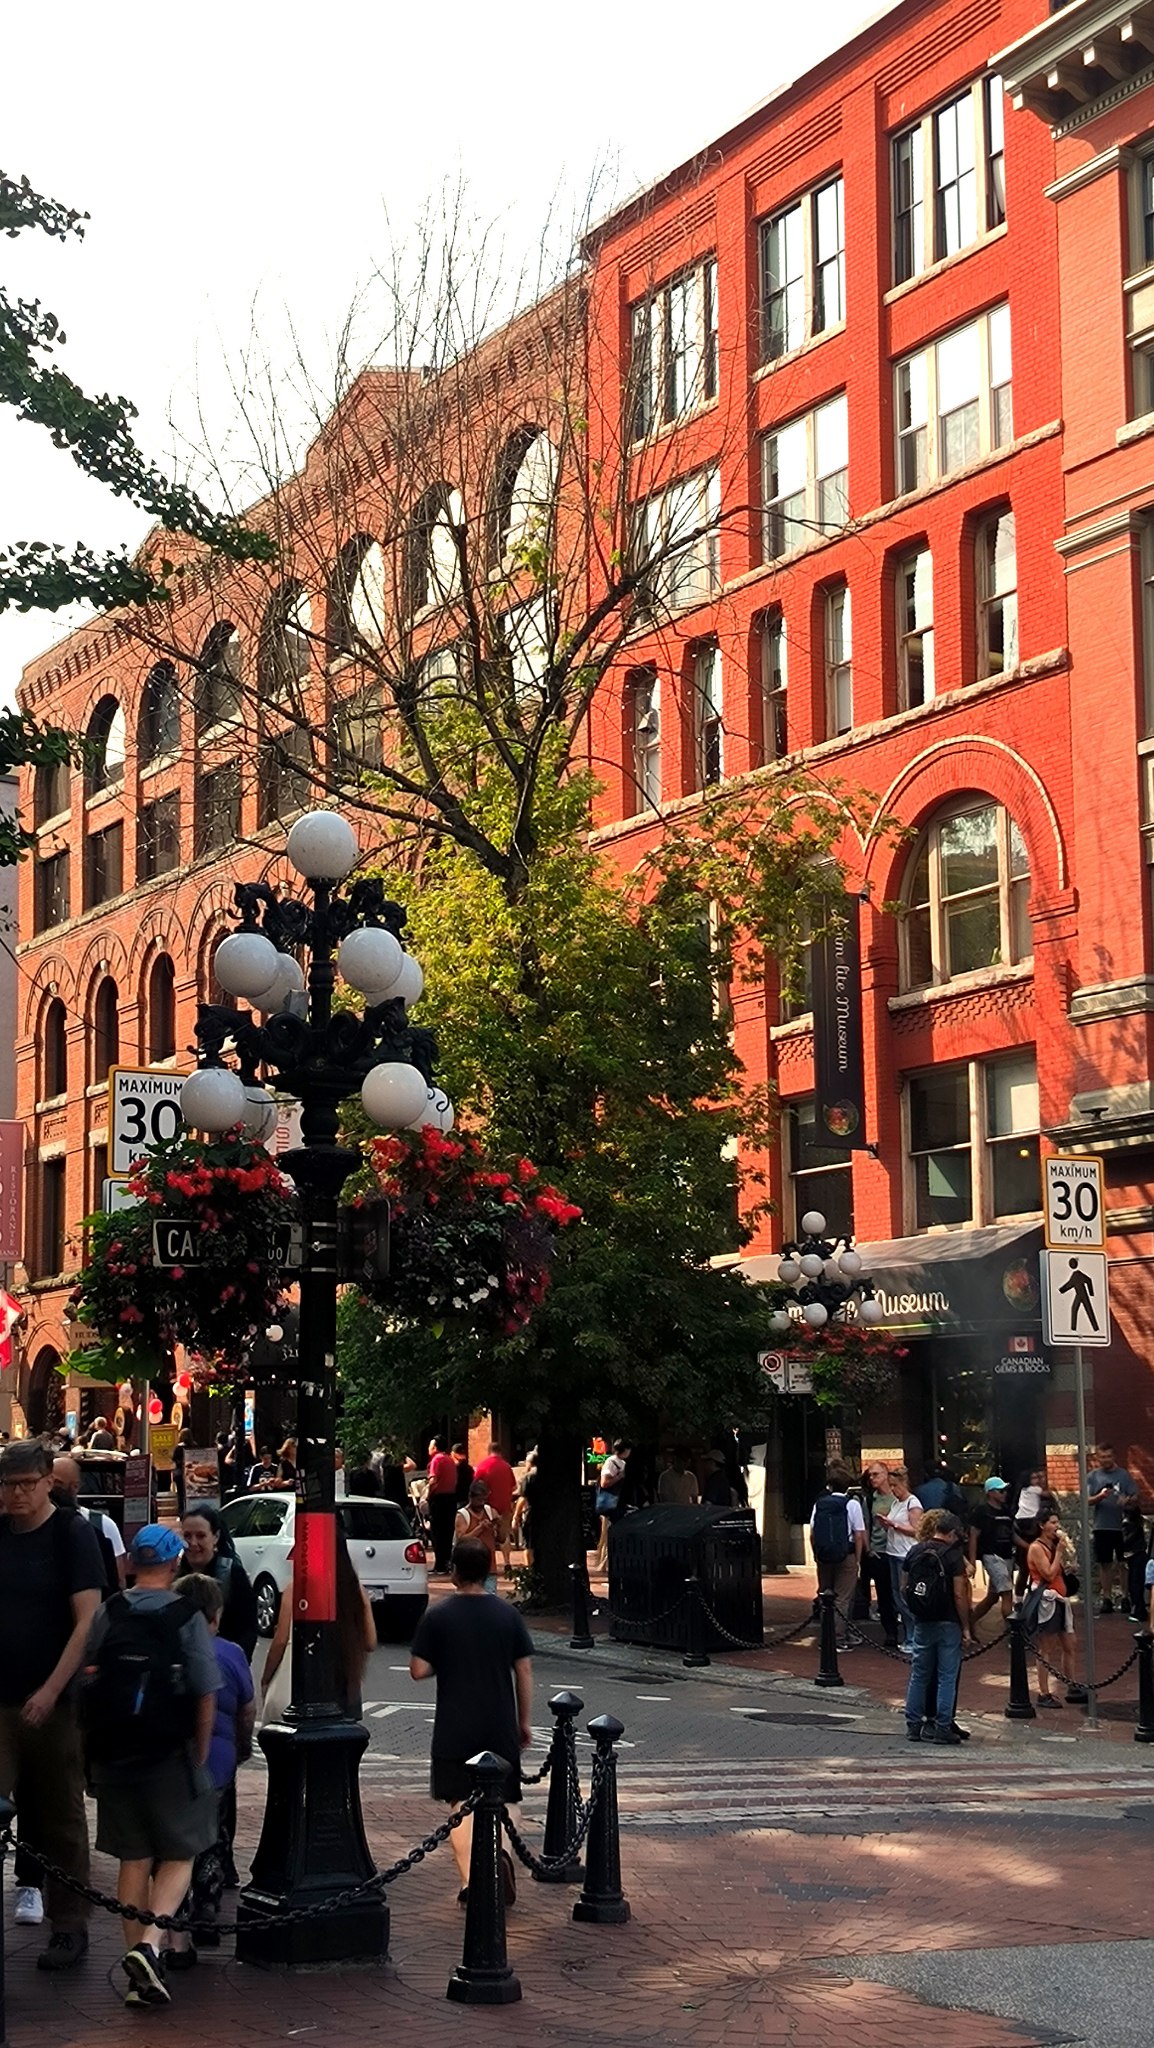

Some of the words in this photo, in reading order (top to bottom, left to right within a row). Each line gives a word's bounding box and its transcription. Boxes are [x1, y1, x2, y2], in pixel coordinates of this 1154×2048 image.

[835, 996, 850, 1073] Museum
[119, 1079, 183, 1095] MAXIMUM
[119, 1097, 183, 1145] 30
[1050, 1166, 1097, 1178] MAXIMUM
[1052, 1181, 1098, 1222] 30
[1060, 1224, 1092, 1239] km/h
[994, 1364, 1017, 1373] GEMS
[1018, 1365, 1024, 1373] &
[1025, 1364, 1051, 1373] ROCKS
[1001, 1357, 1044, 1365] CANADIAN
